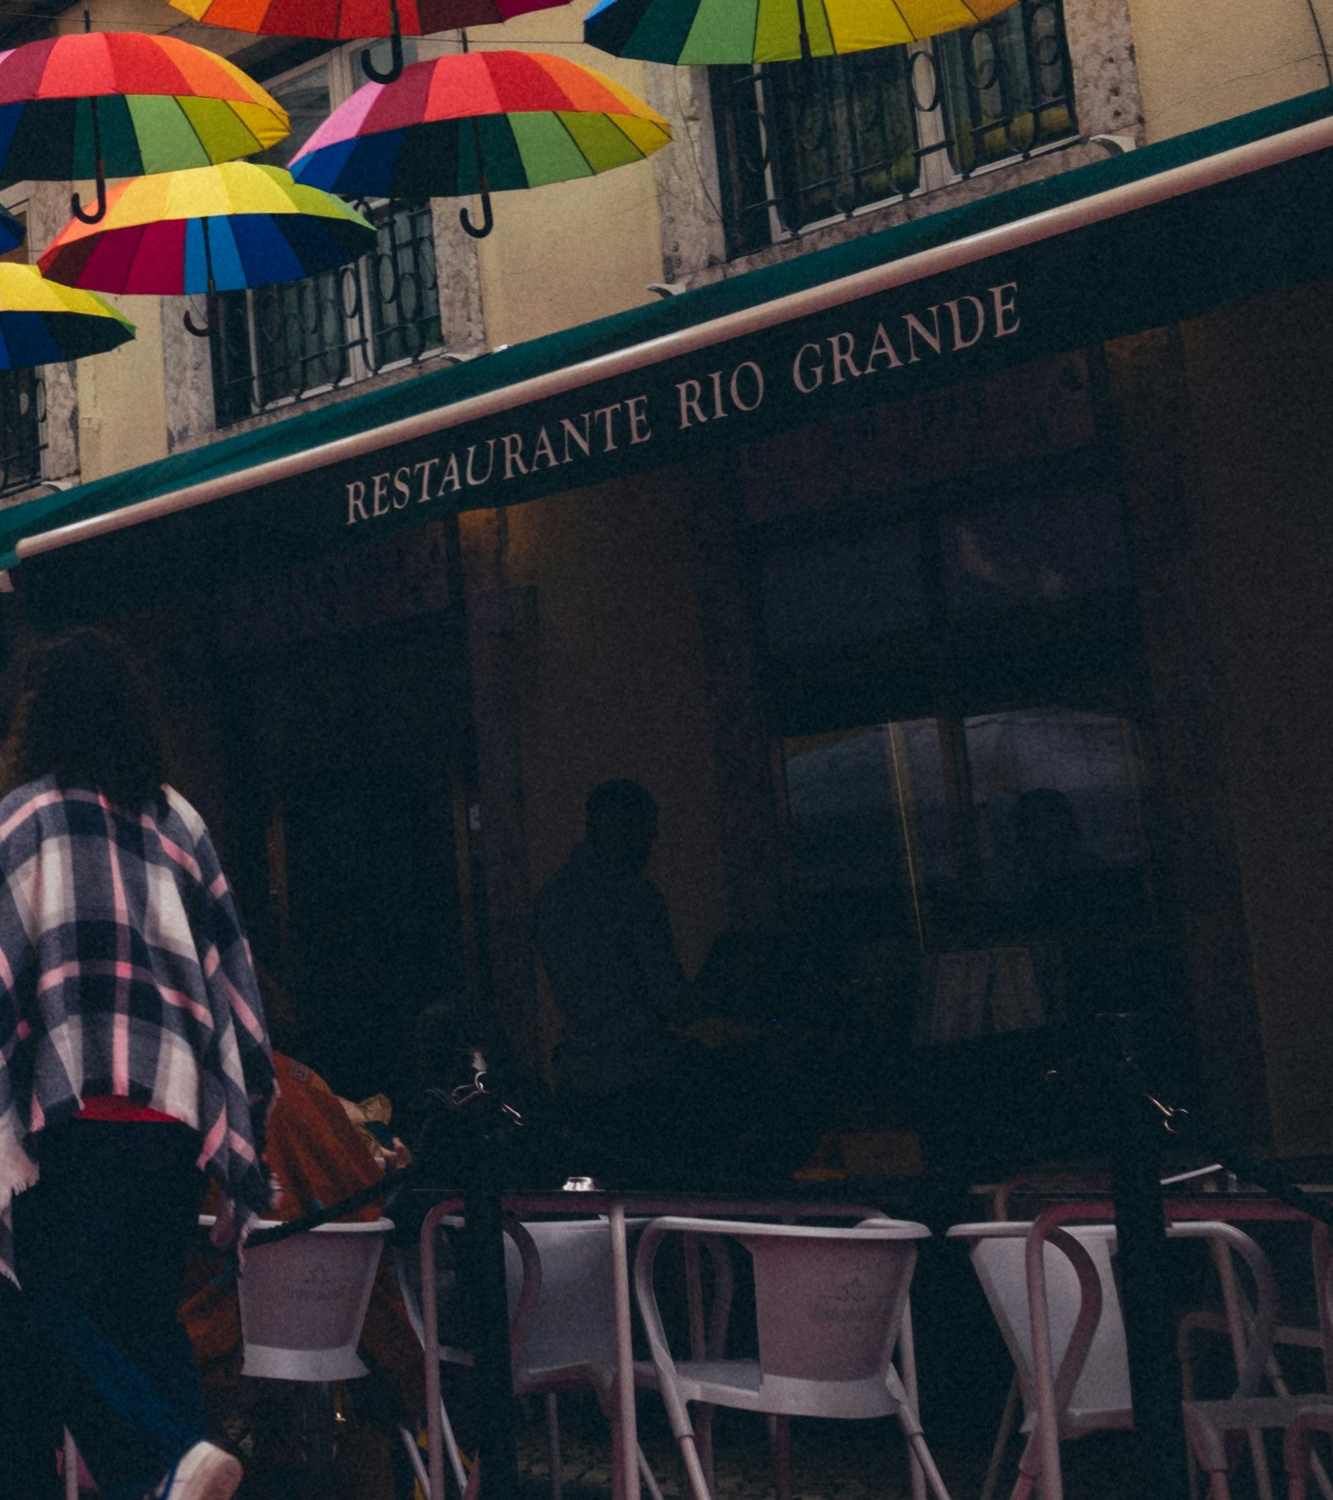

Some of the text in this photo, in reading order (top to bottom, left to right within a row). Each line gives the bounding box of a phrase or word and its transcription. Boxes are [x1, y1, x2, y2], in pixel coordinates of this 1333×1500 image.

[345, 281, 1022, 526] RESTAURANTE RIO GRANDE
